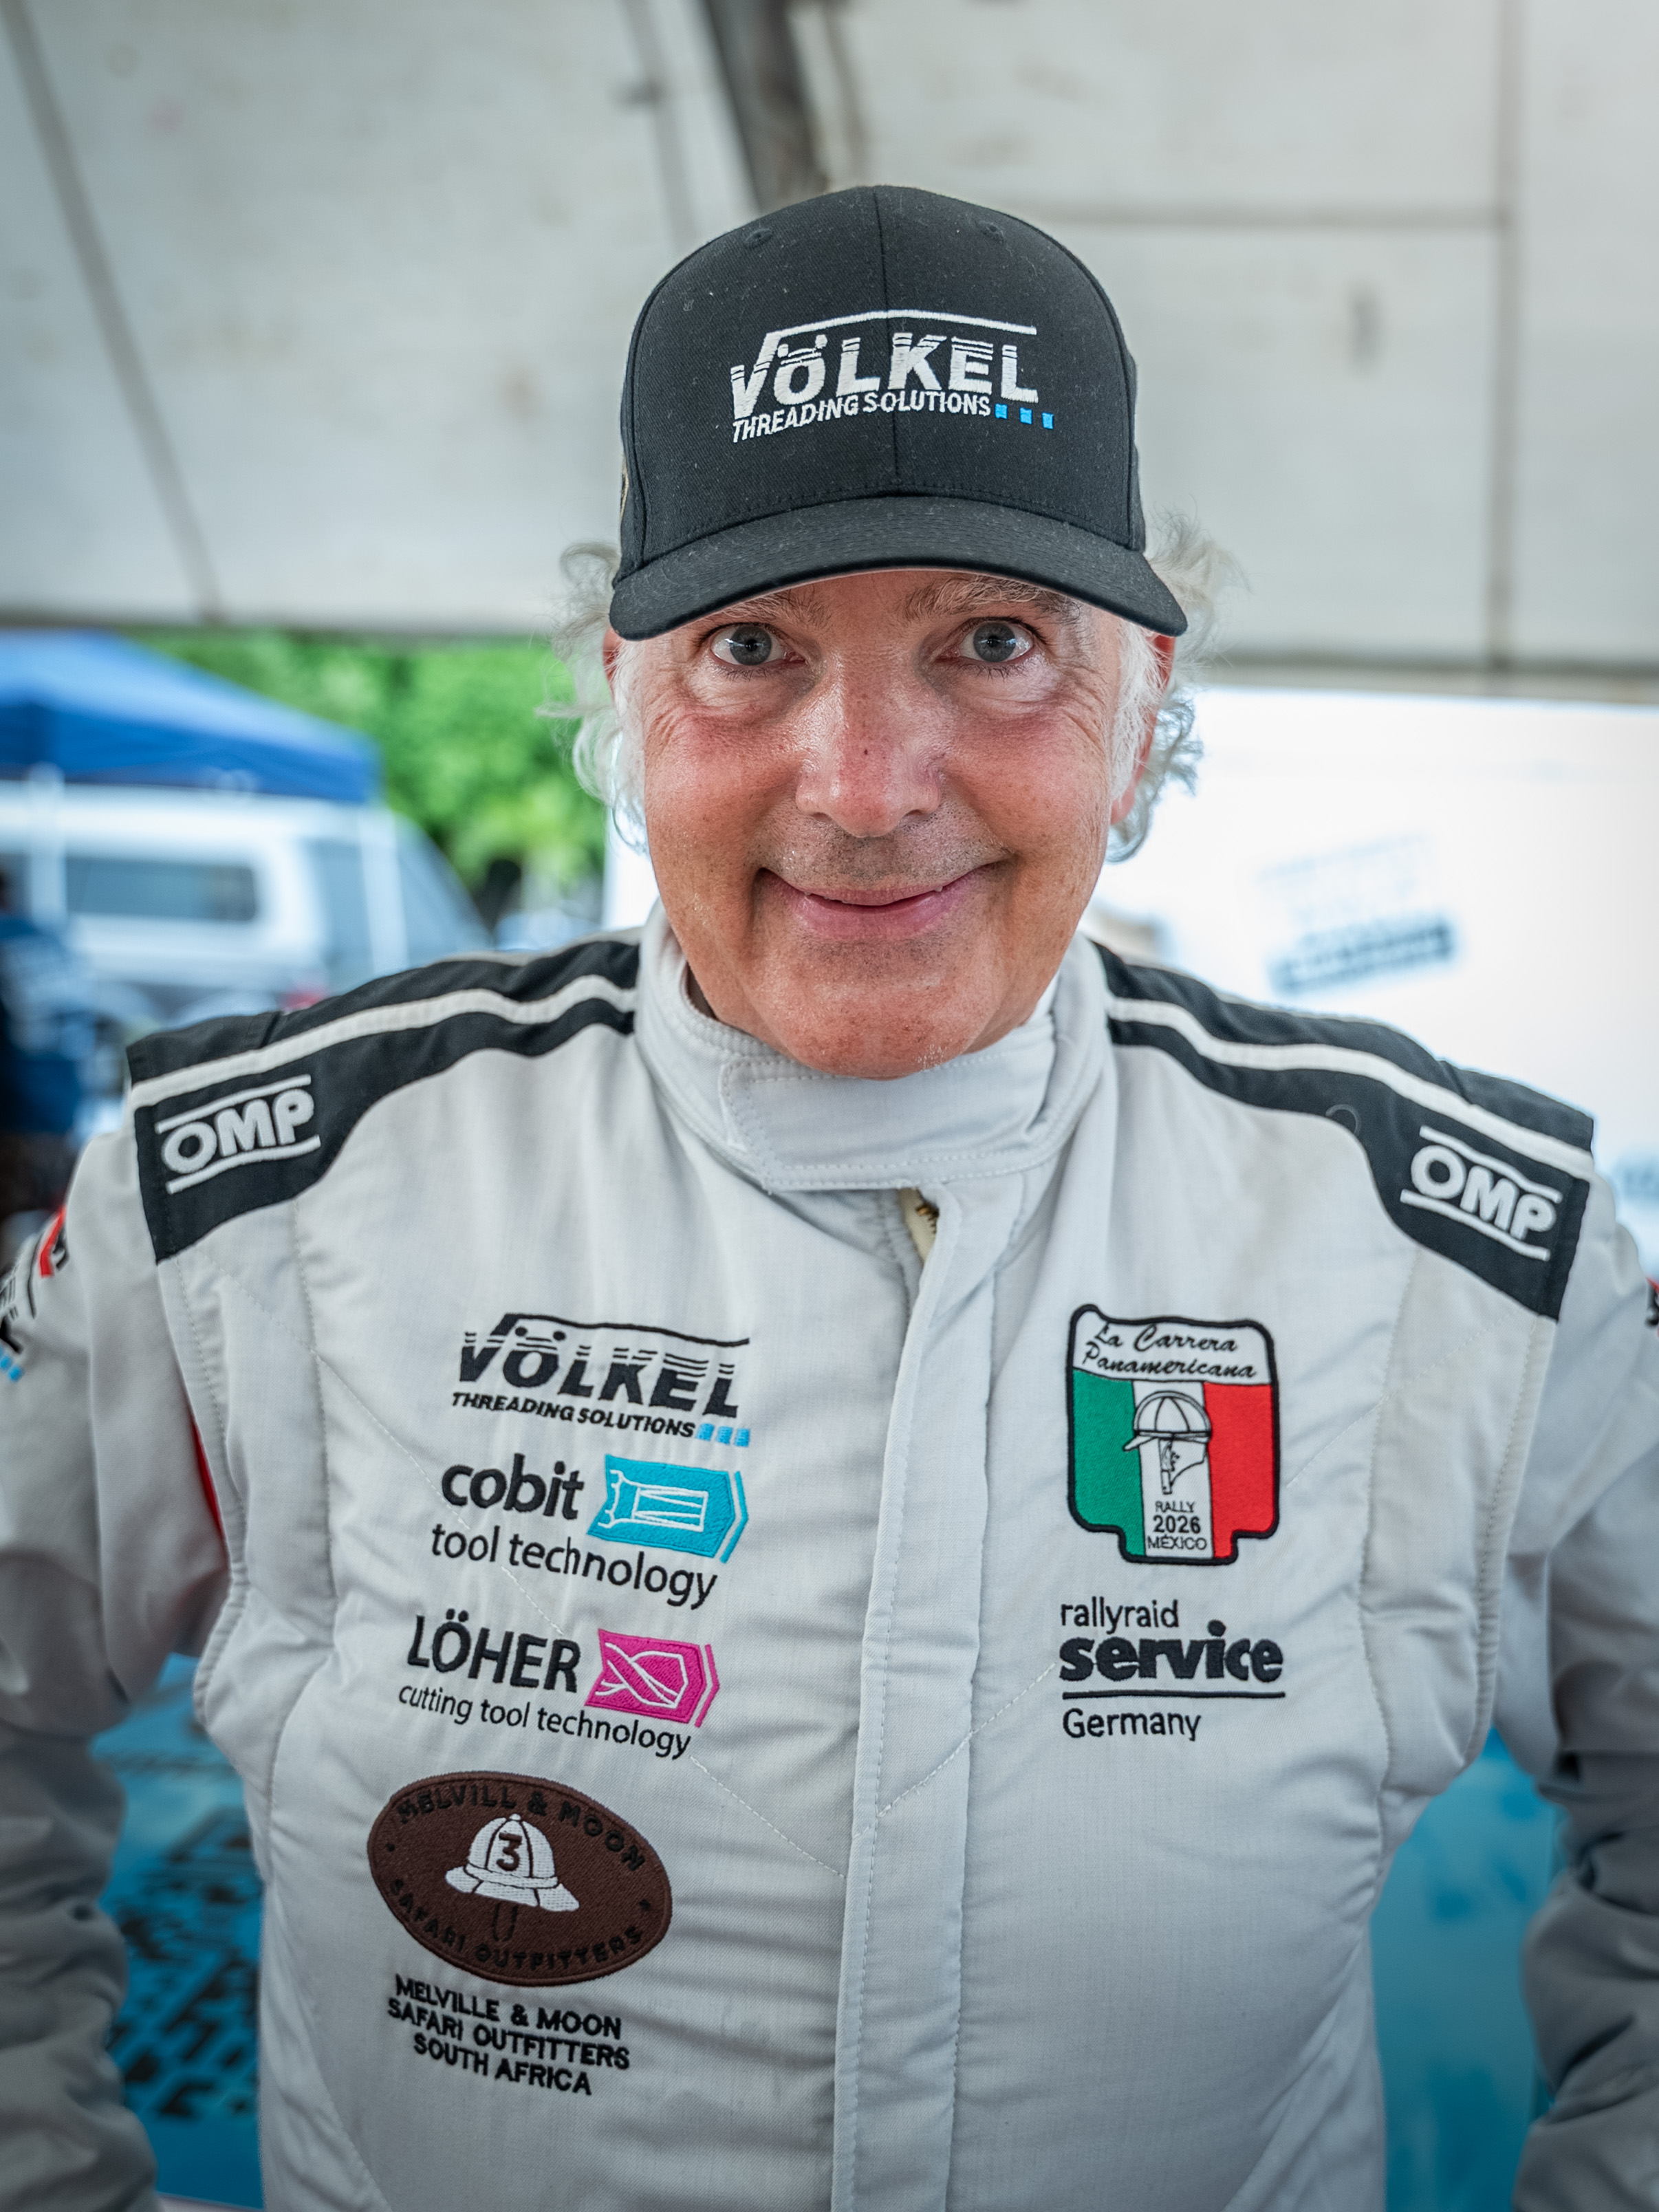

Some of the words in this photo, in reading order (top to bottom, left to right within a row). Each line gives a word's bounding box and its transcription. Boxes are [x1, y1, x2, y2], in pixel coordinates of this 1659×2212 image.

[730, 331, 1039, 420] VÖLKEL
[733, 394, 858, 443] THREADING
[863, 391, 991, 417] SOLUTIONS
[162, 1089, 315, 1174] OMP
[1411, 1145, 1557, 1240] OMP
[459, 1313, 739, 1418] VÖLKEL
[1083, 1341, 1257, 1378] Panamericana
[1094, 1323, 1123, 1346] La
[1134, 1323, 1238, 1353] Carrera
[452, 1391, 573, 1422] THREADING
[576, 1407, 695, 1438] SOLUTIONS
[442, 1453, 585, 1521] cobit
[1156, 1501, 1195, 1513] RALLY
[1147, 1532, 1208, 1550] MÉXICO
[1153, 1515, 1202, 1535] 2026
[431, 1524, 500, 1563] tool
[509, 1533, 718, 1611] technology
[1061, 1596, 1179, 1635] rallyraid
[407, 1608, 581, 1693] LÖHER
[1059, 1619, 1283, 1682] service
[398, 1684, 473, 1725] cutting
[481, 1698, 531, 1728] tool
[537, 1706, 692, 1760] technology
[1063, 1707, 1202, 1742] Germany
[397, 1784, 517, 1825] MELVILL
[527, 1792, 547, 1817] &
[559, 1801, 645, 1872] MOON
[496, 1832, 523, 1872] 3
[390, 1878, 466, 1951] SAFARI
[475, 1925, 643, 1971] OUTFITTERS
[388, 1997, 464, 2041] SAFARI
[473, 2024, 630, 2070] OUTFITTERS
[395, 1973, 501, 2022] MELVILLE
[511, 2004, 530, 2028] &
[537, 2007, 622, 2040] MOON
[414, 2032, 488, 2076] SOUTH
[495, 2058, 592, 2096] AFRICA
